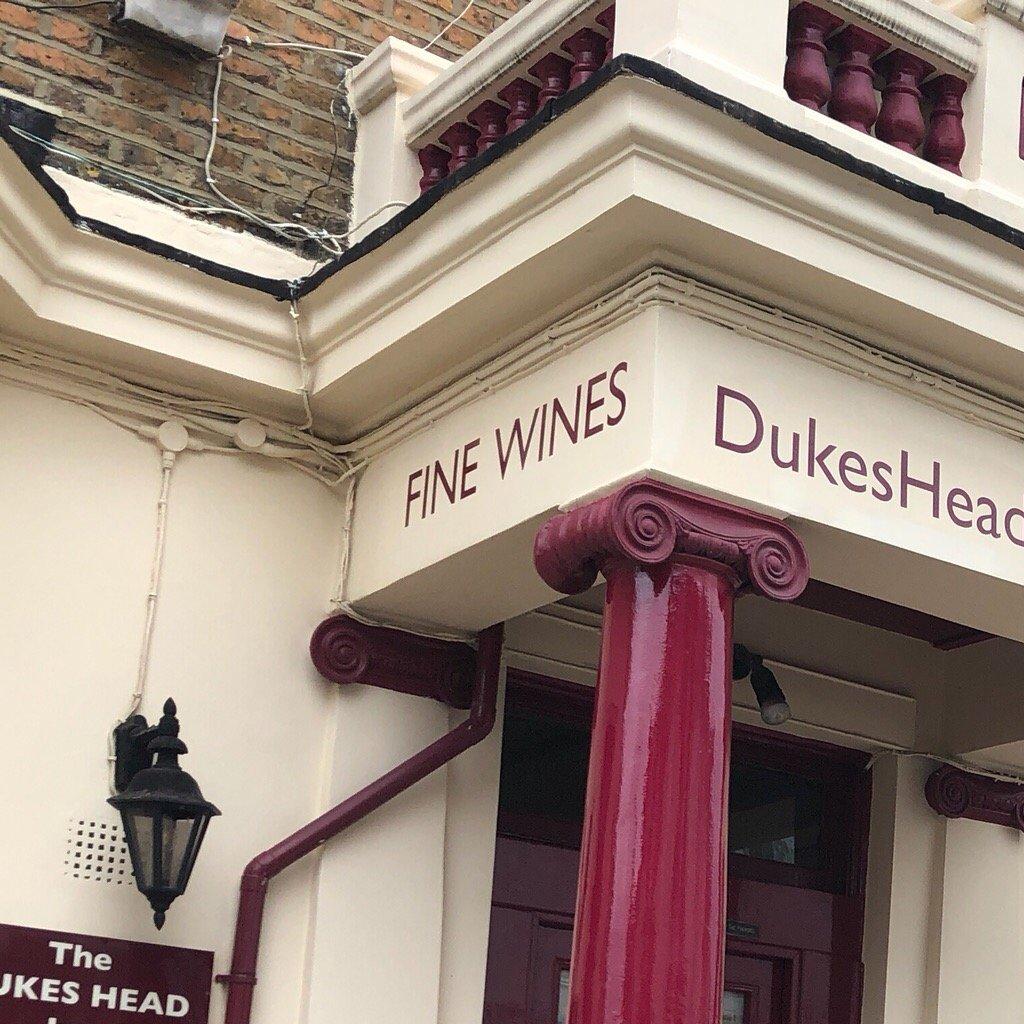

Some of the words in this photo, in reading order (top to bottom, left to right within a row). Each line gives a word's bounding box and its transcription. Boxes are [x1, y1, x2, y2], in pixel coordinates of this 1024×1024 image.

[404, 437, 481, 528] FINE
[495, 361, 628, 480] WINES
[49, 940, 113, 971] The
[91, 984, 190, 1018] HEAD
